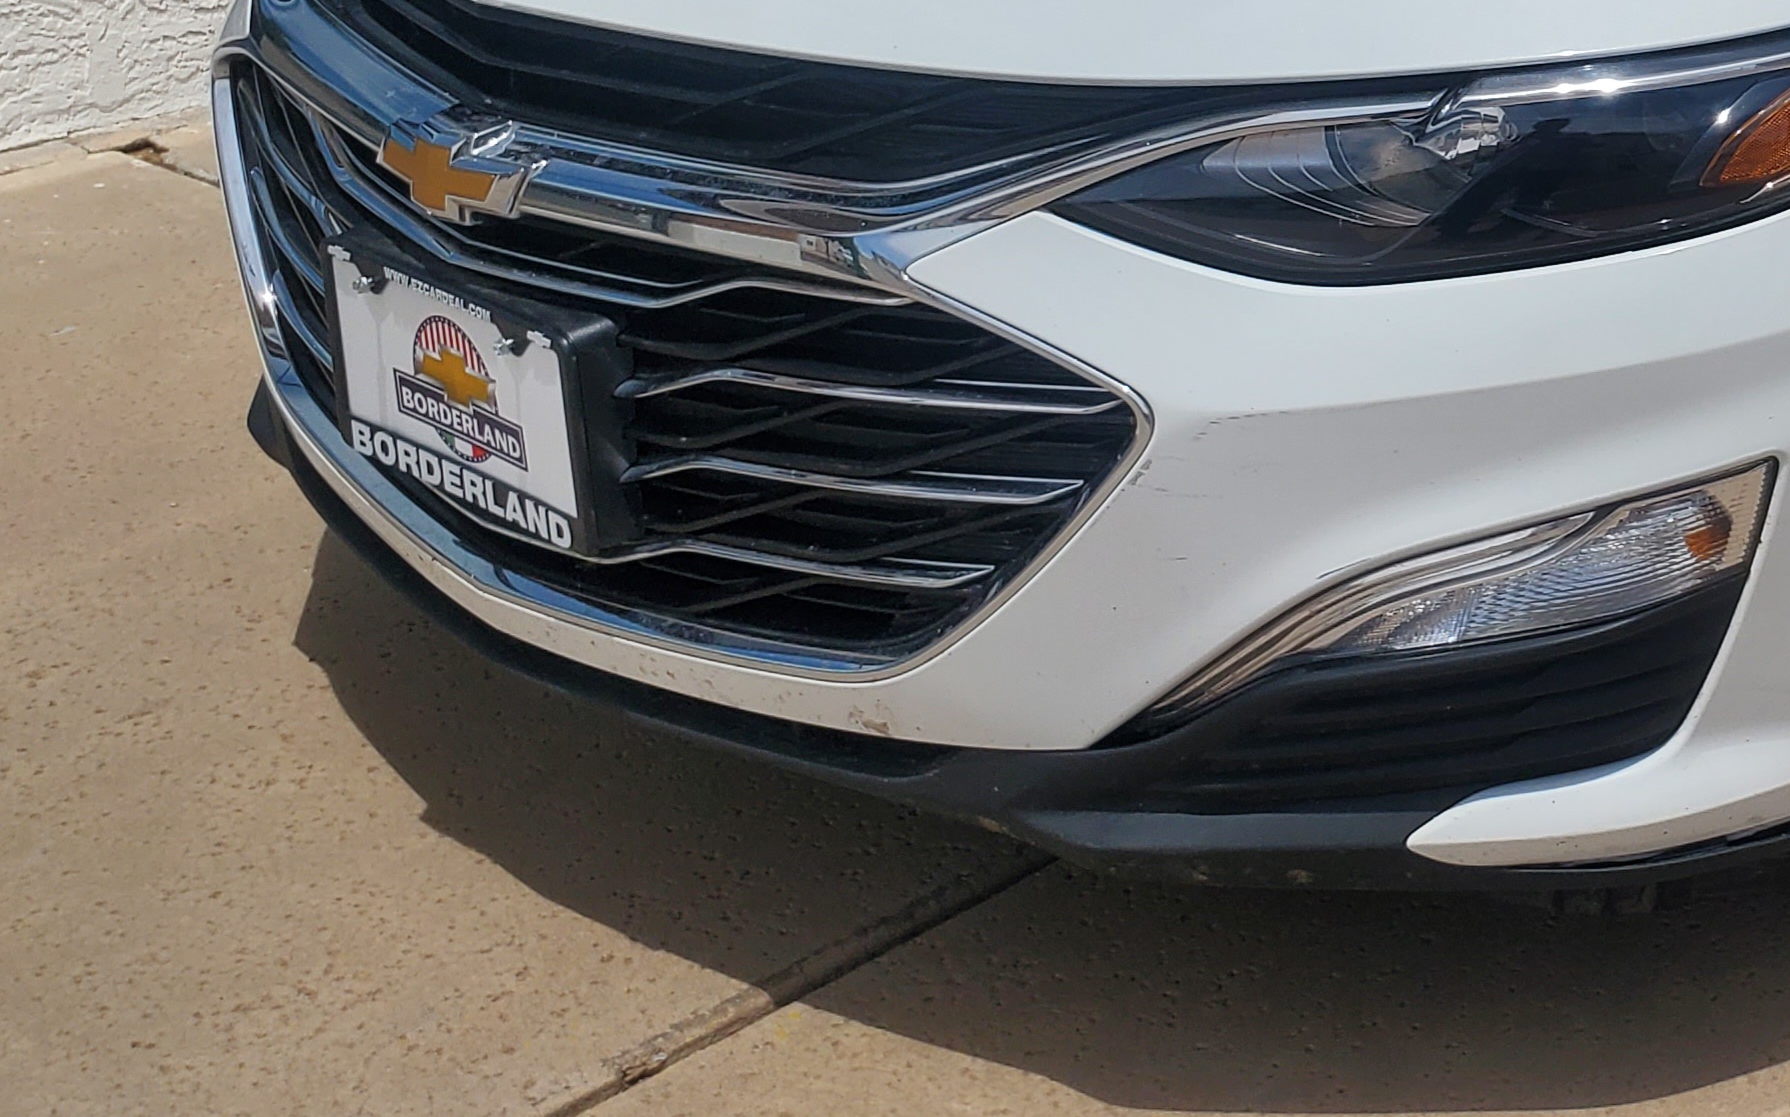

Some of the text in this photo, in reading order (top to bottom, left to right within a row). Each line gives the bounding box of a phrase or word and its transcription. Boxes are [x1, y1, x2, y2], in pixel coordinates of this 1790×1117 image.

[383, 265, 492, 323] WWW.EZCARDEAL.COM
[401, 385, 522, 459] BORDERLAND
[350, 419, 573, 549] BORDERLAND
